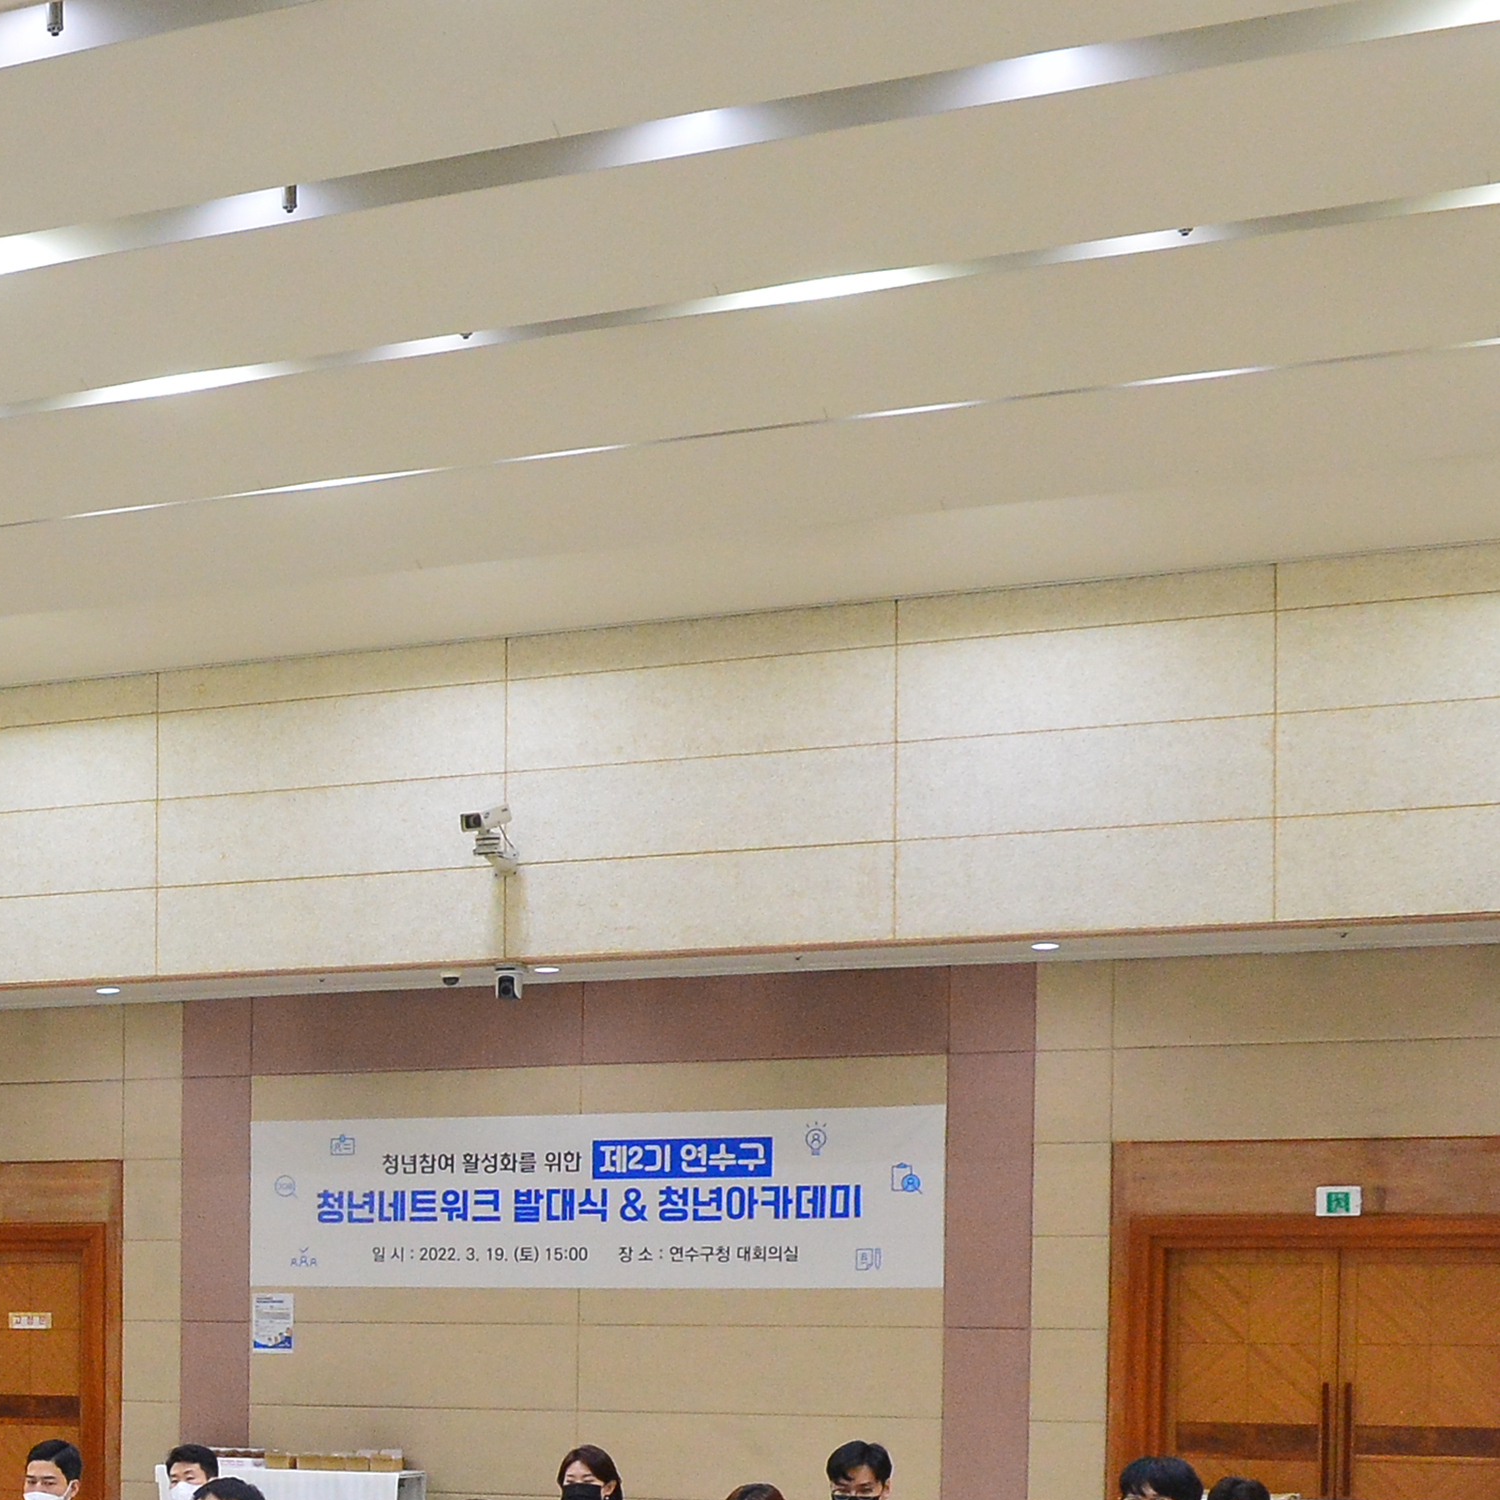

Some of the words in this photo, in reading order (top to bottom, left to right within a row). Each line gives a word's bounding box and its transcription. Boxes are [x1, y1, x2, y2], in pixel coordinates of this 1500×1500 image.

[382, 1153, 456, 1175] 청년참여
[461, 1151, 537, 1174] 활성화를
[543, 1151, 582, 1173] 위한
[599, 1144, 671, 1173] 제2기
[680, 1143, 767, 1172] 연수구
[315, 1189, 501, 1224] 청년네트워크
[513, 1188, 609, 1223] 발대식
[619, 1187, 648, 1222] &
[658, 1184, 862, 1222] 청년아카데미
[419, 1247, 461, 1262] 2022.
[466, 1247, 479, 1262] 3.
[487, 1247, 508, 1262] 19.
[514, 1247, 539, 1262] (토)
[545, 1247, 588, 1262] 15:00
[670, 1246, 730, 1262] 연수구청
[736, 1246, 799, 1262] 대회의실
